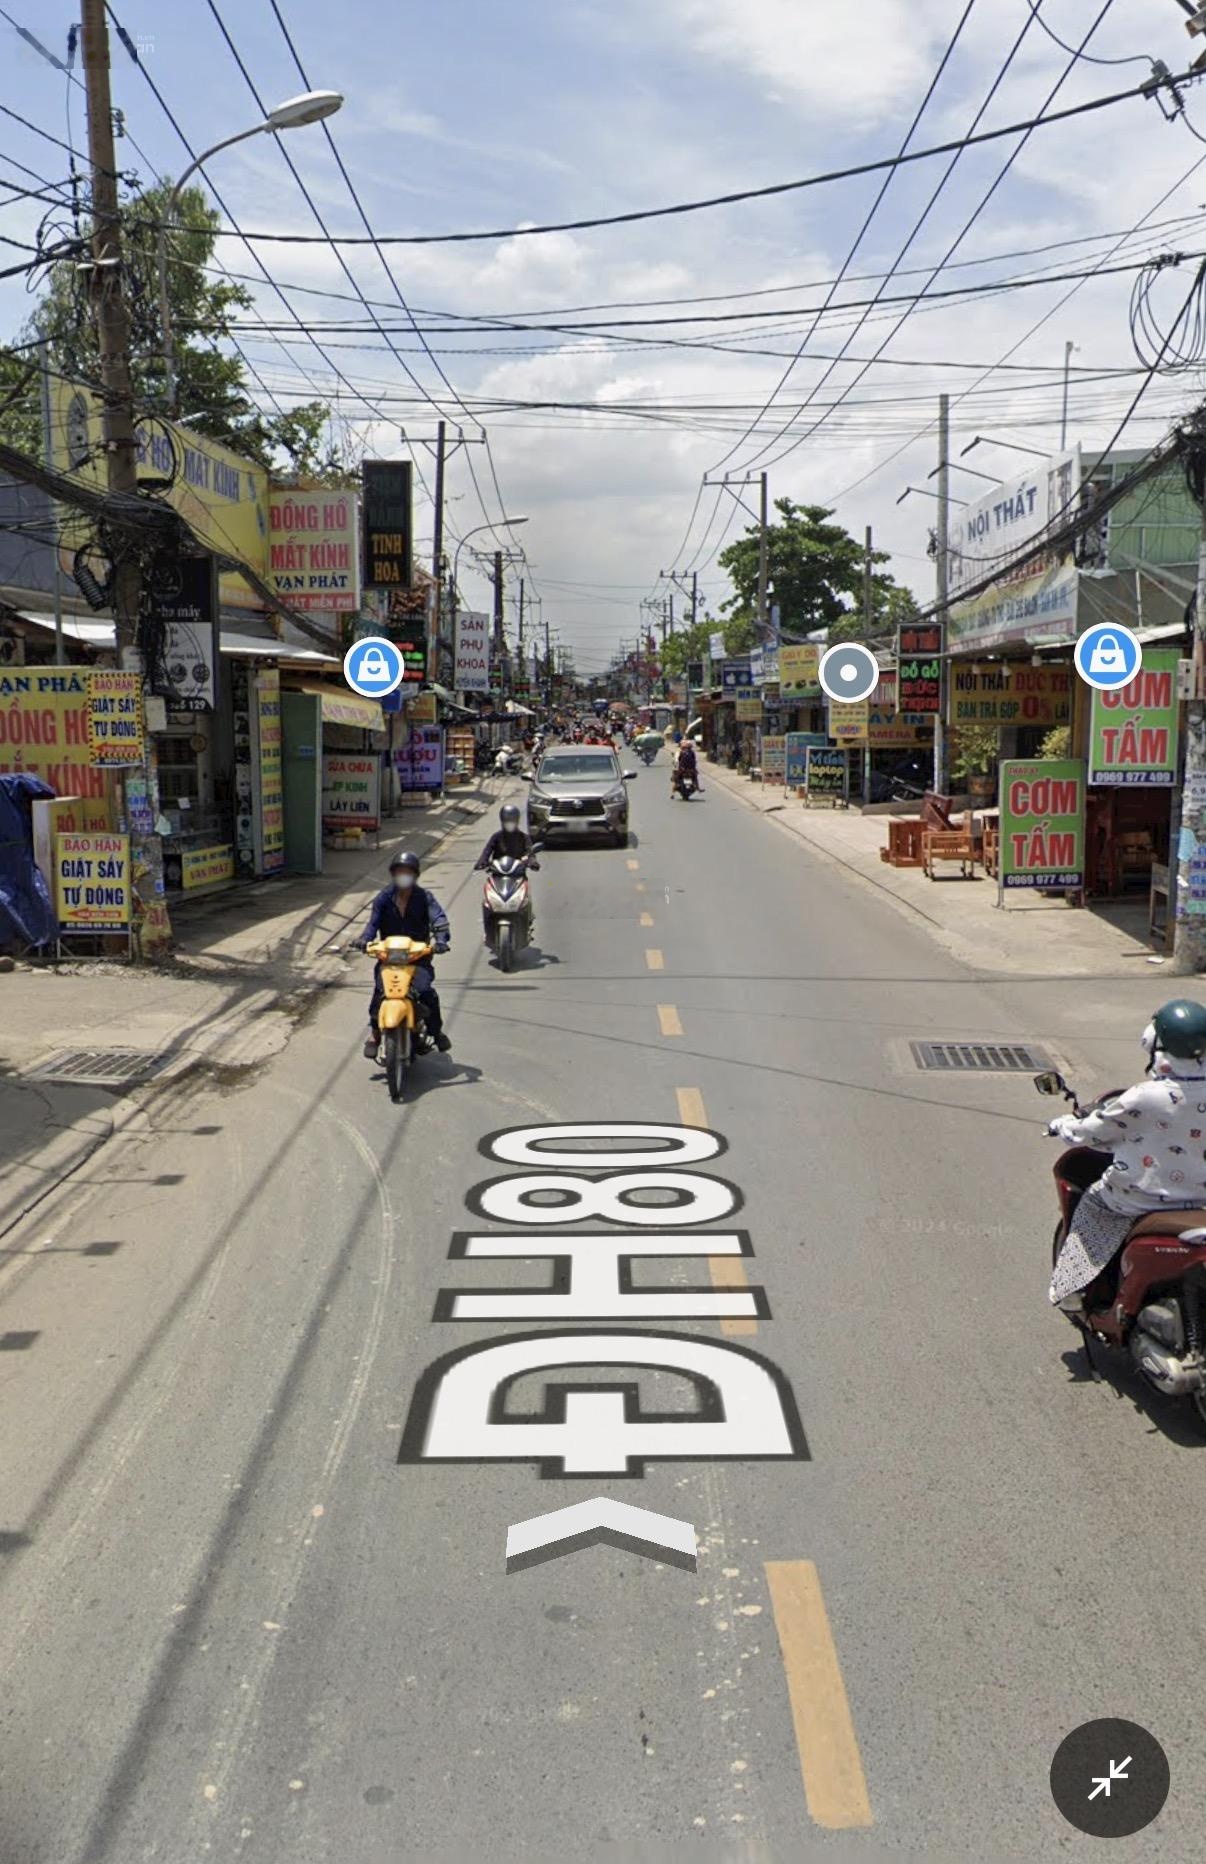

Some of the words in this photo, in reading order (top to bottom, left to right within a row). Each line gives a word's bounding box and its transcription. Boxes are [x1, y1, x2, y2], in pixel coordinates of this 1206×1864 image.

[968, 510, 989, 542] NỘI
[993, 481, 1037, 526] THẤT
[274, 575, 304, 592] VẠN
[309, 572, 347, 588] PHÁT
[374, 560, 400, 583] HOA
[461, 615, 484, 630] SẢN
[460, 639, 483, 651] PHỤ
[457, 659, 486, 669] KHOA
[0, 676, 30, 696] ẠN
[1102, 716, 1168, 764] TẤM
[1126, 771, 1147, 782] 977
[1010, 778, 1077, 815] CƠM
[1011, 822, 1075, 868] TẤM
[98, 853, 124, 878] SẤY
[63, 885, 83, 908] TỰ
[85, 884, 124, 908] ĐỘNG
